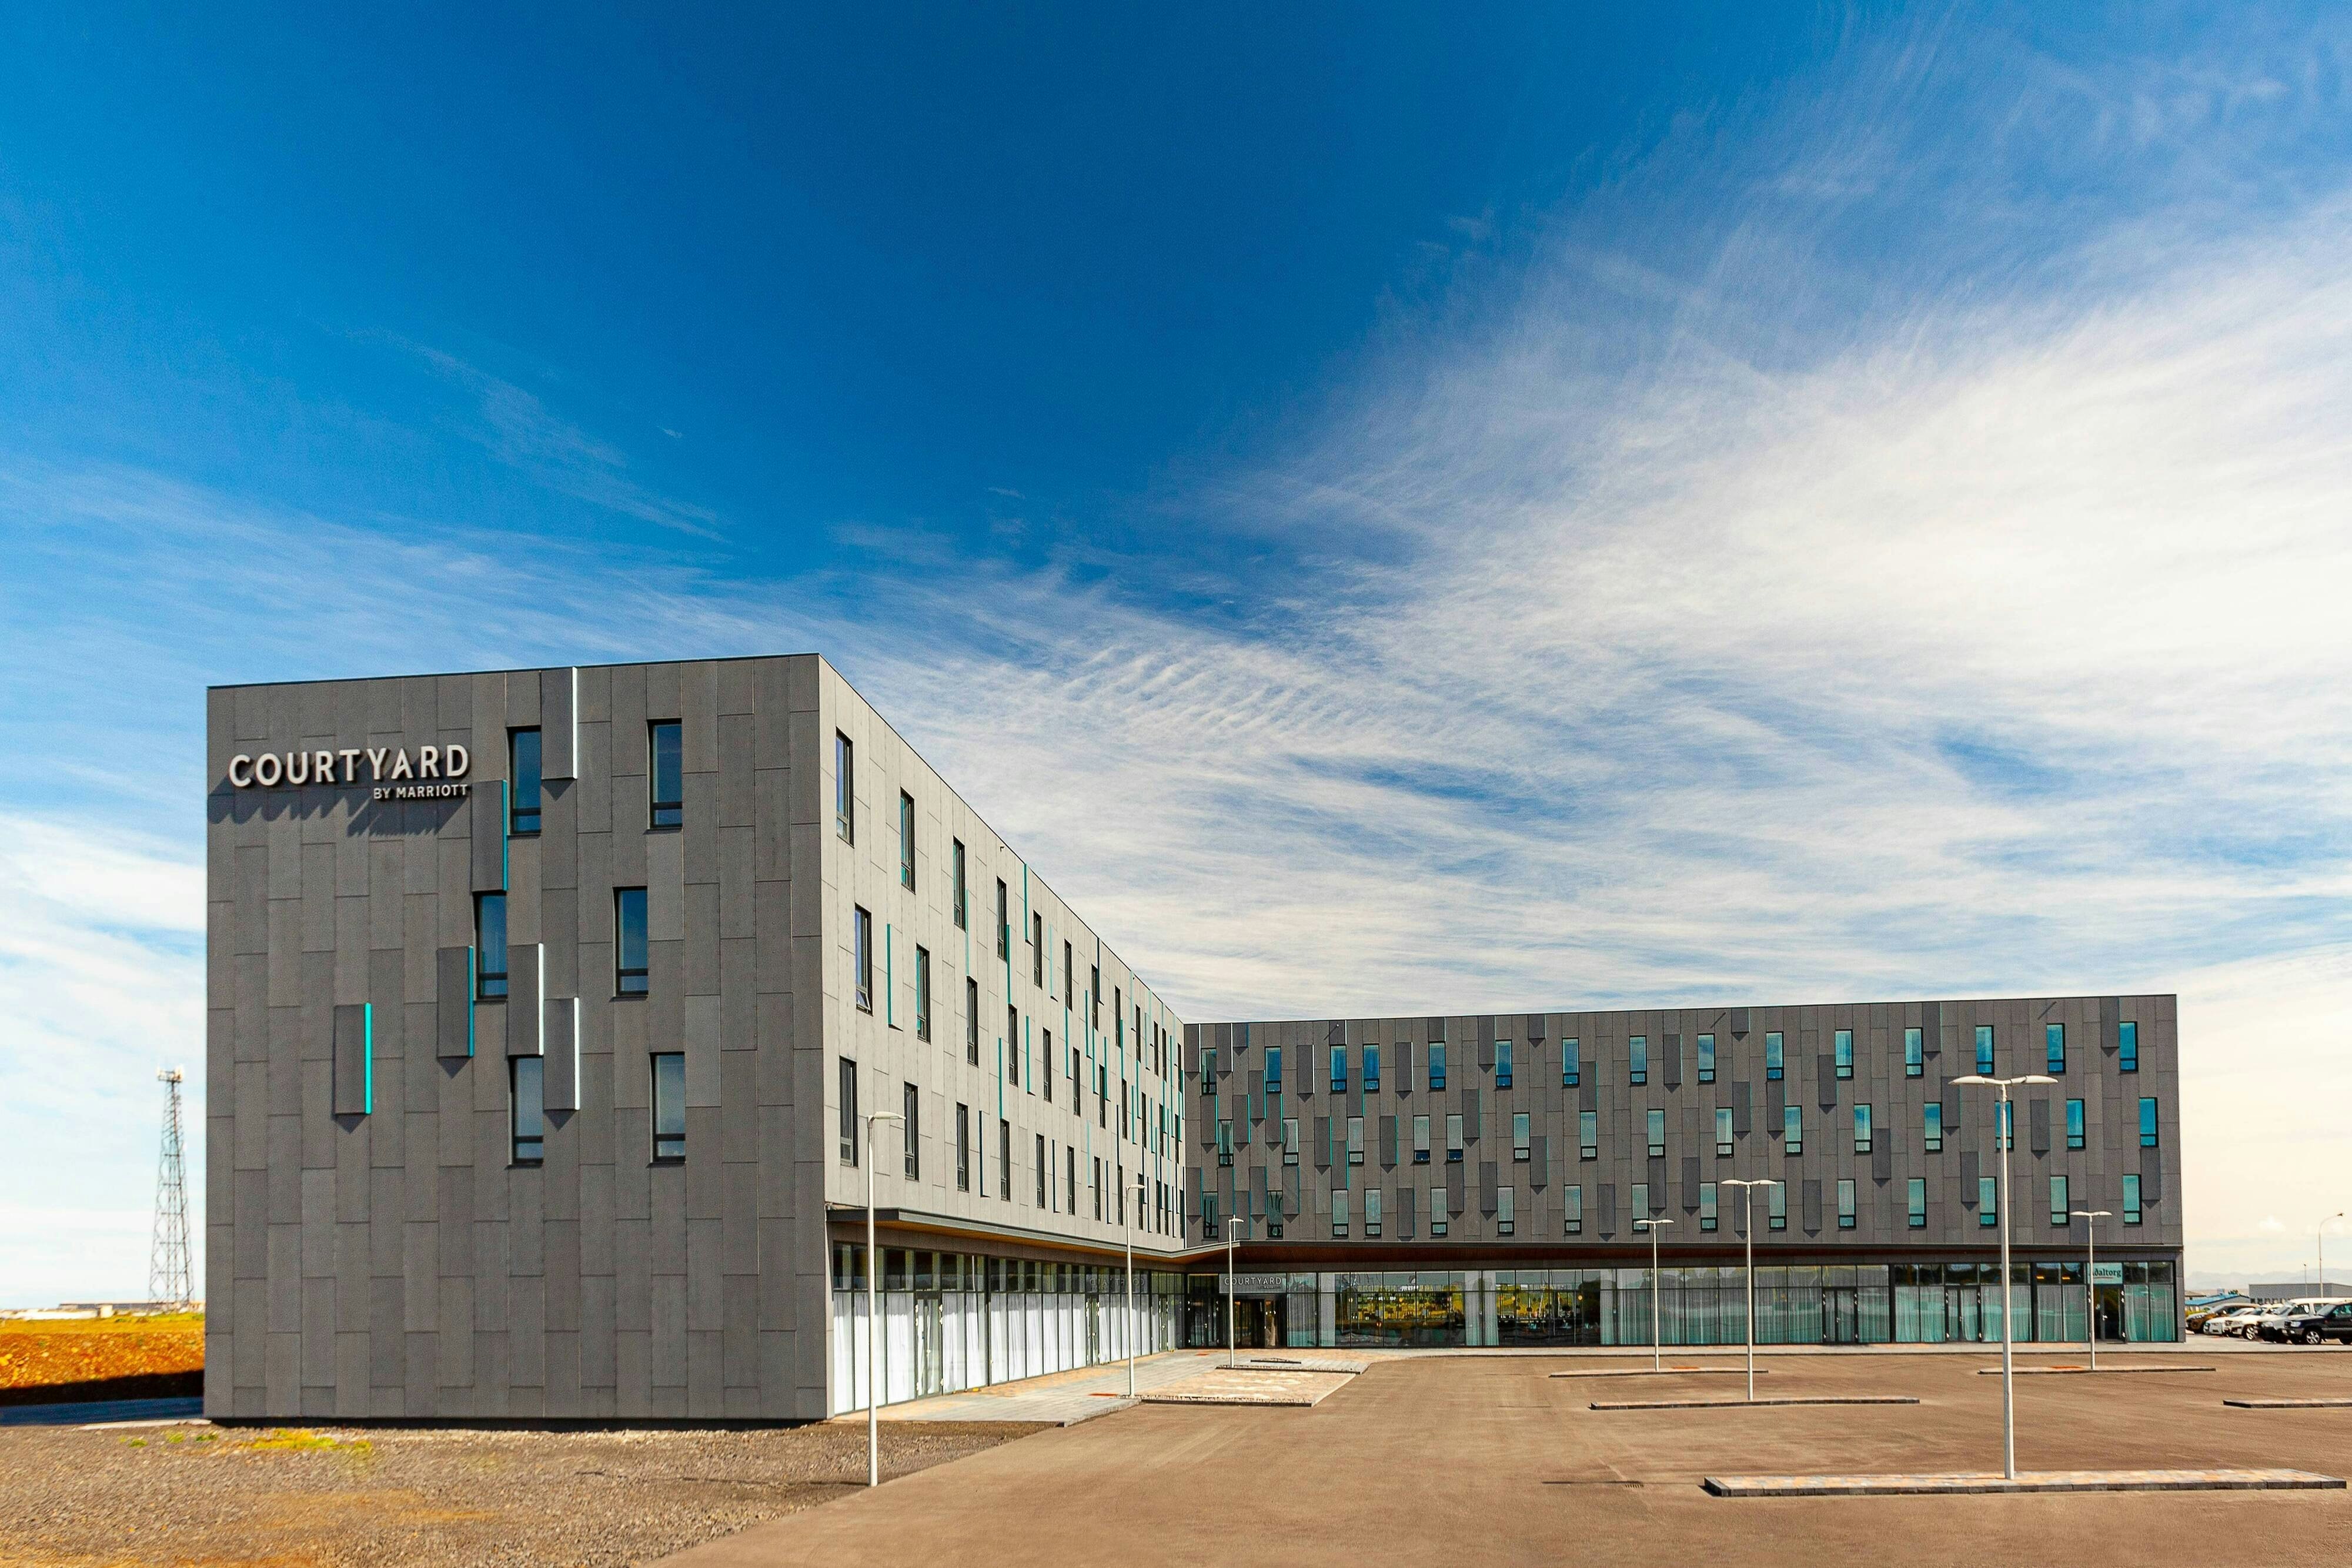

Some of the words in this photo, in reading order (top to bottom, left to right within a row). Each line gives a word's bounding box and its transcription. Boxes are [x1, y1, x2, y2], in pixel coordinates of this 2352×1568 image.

[229, 744, 469, 787] COURTYARD
[373, 788, 391, 799] BY
[396, 784, 468, 798] MARRIOTT
[2089, 1268, 2121, 1278] ðaltorg
